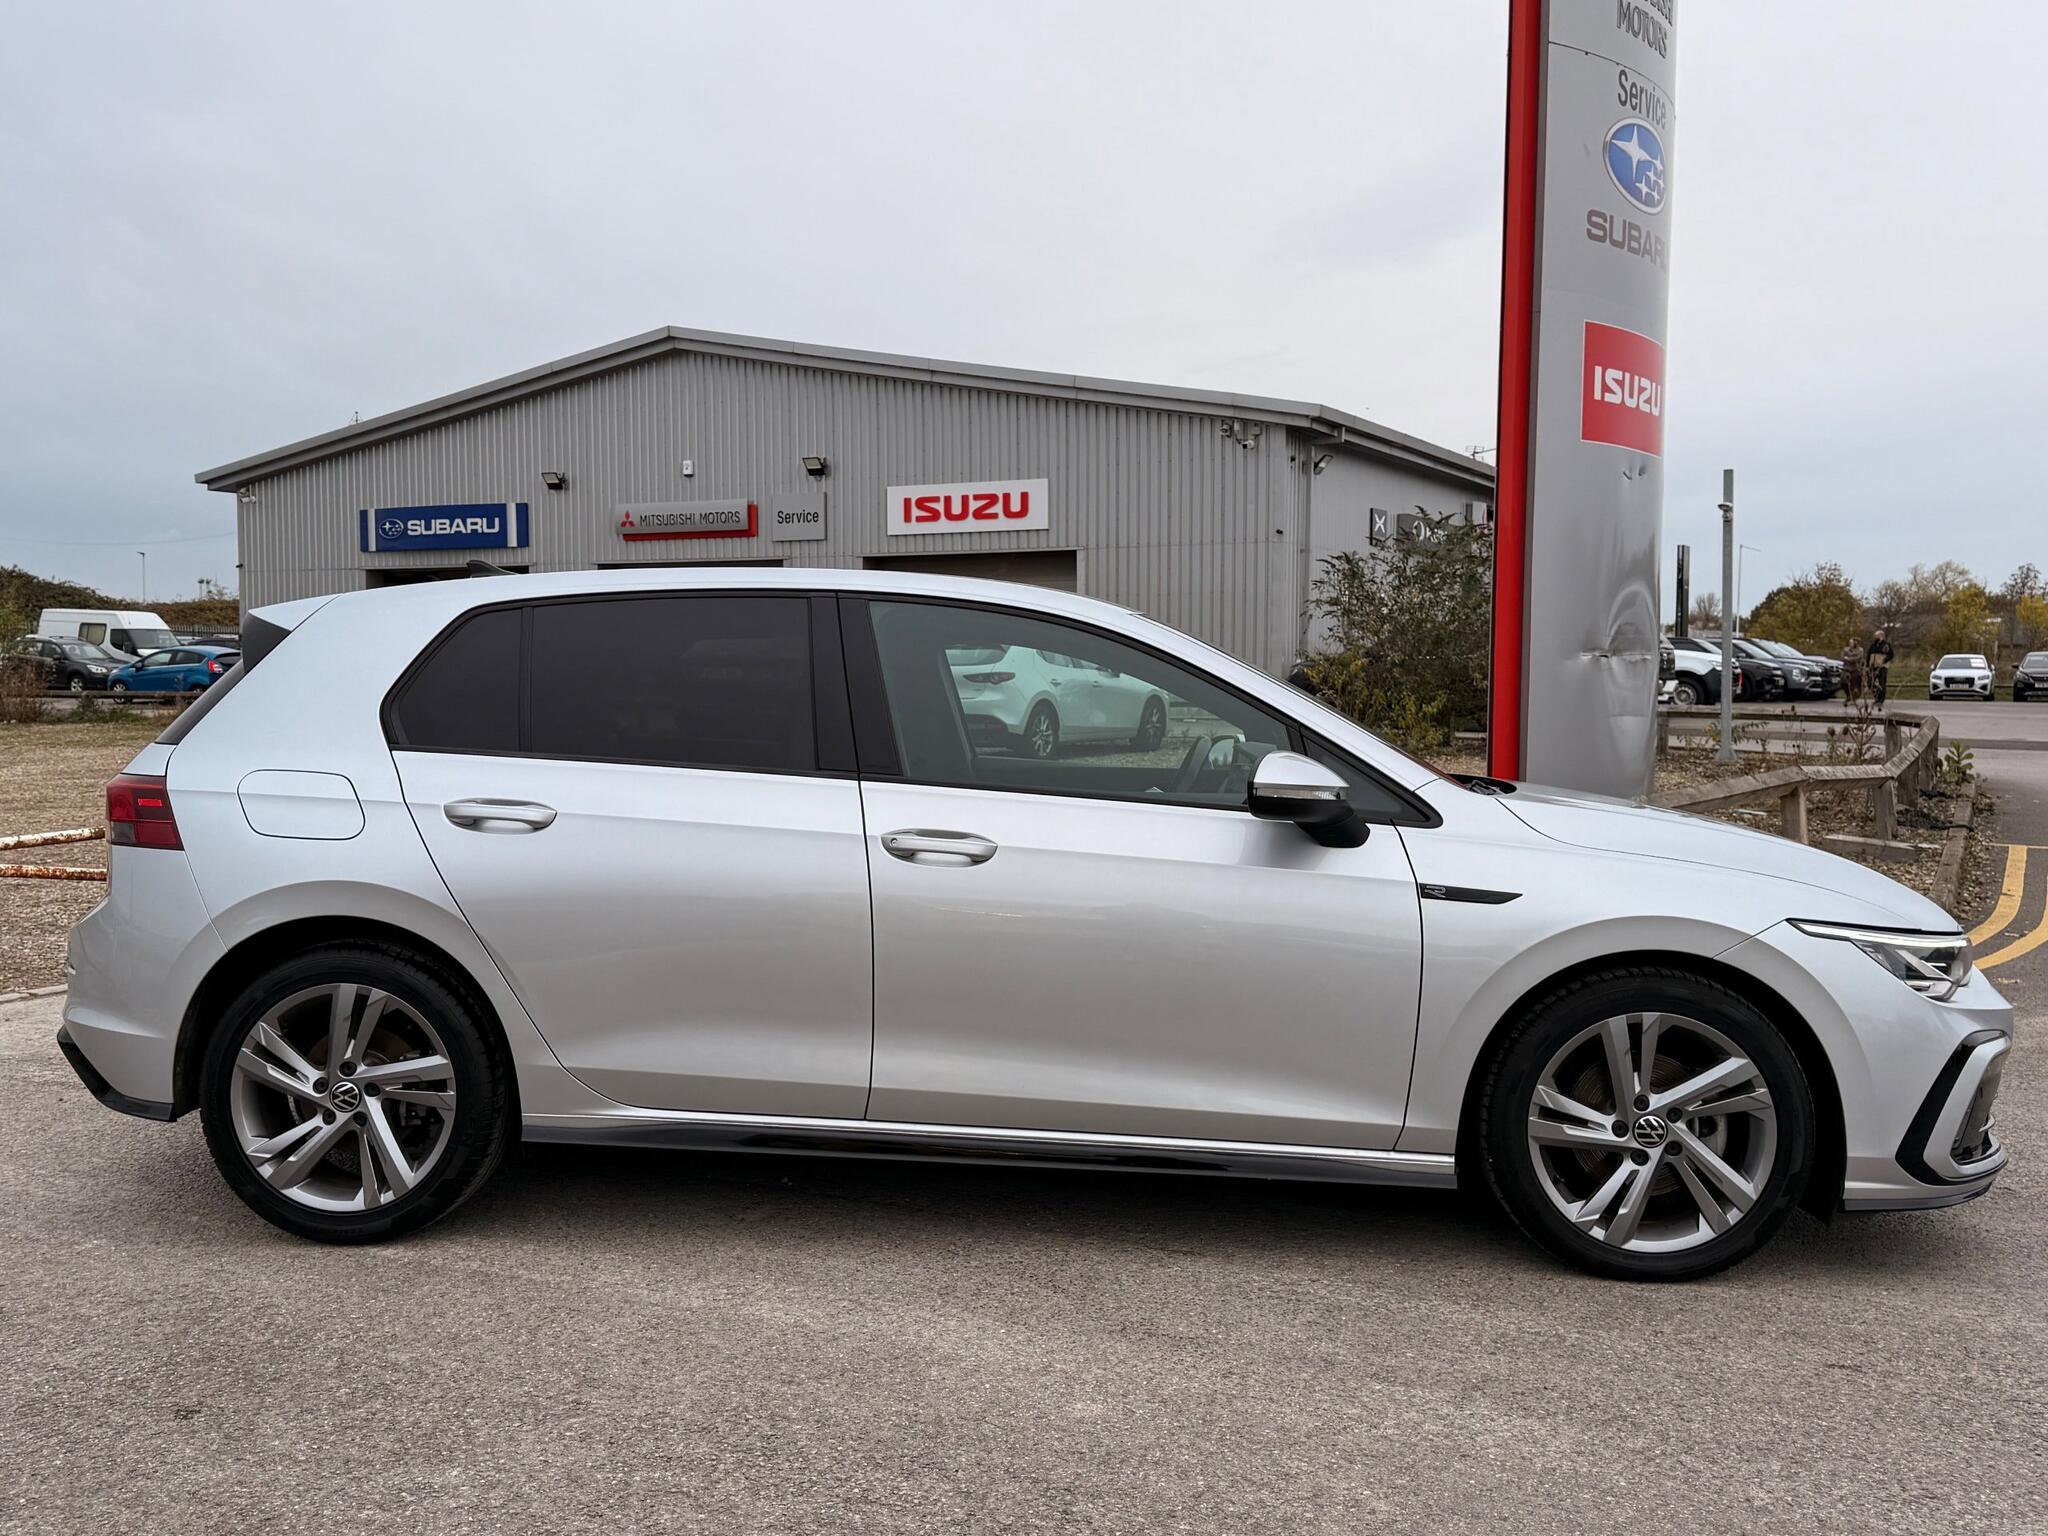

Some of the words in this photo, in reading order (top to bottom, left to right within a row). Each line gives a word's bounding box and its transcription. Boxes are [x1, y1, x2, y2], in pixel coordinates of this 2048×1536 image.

[1616, 0, 1668, 59] MOTORS
[1617, 69, 1666, 130] Service
[1586, 208, 1665, 269] SUBAR
[1593, 365, 1661, 417] ISUZU
[407, 517, 500, 536] SUBARU
[639, 512, 696, 528] MITSUBISHI
[699, 510, 741, 525] MOTORS
[776, 509, 820, 525] Service
[903, 491, 1030, 524] ISUZU
